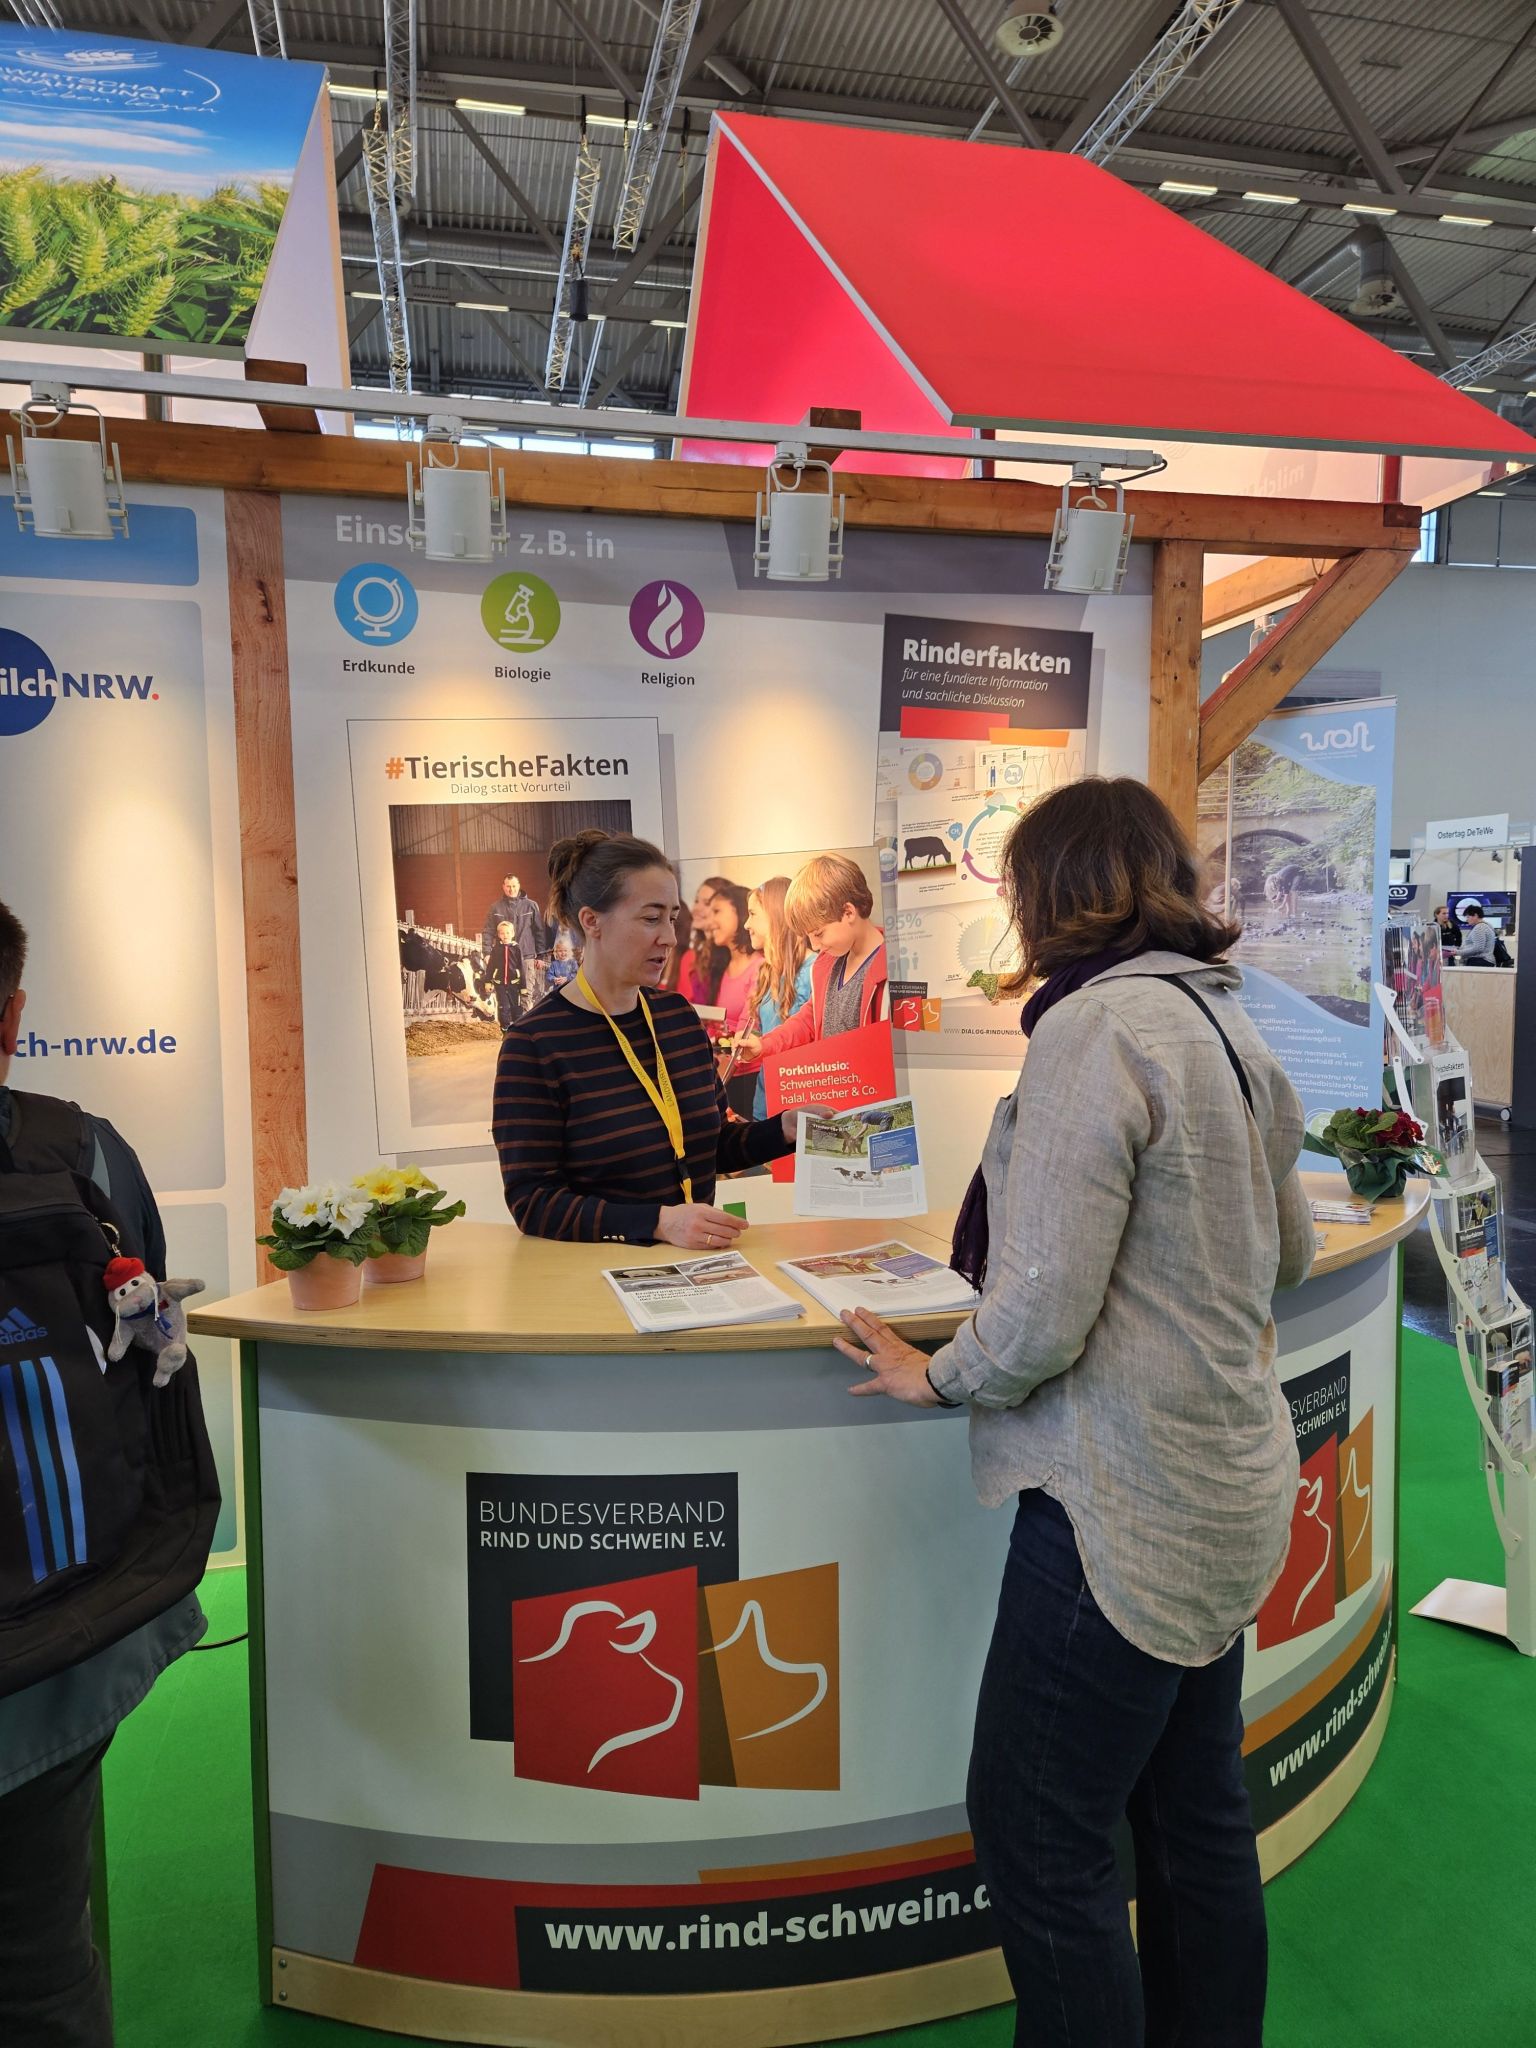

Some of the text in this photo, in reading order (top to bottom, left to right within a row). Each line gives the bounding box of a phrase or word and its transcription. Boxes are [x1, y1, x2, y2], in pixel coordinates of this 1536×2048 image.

[0, 66, 194, 96] WIRTSCHAFT
[519, 530, 576, 557] z.B.
[586, 531, 615, 559] in
[342, 659, 416, 675] Erdkunde
[903, 638, 1071, 675] Rinderfakten
[0, 667, 160, 701] ilchNRW.
[494, 666, 551, 682] Biologie
[641, 672, 695, 687] Religion
[901, 668, 1048, 692] für eine fundierte Information
[902, 689, 1025, 708] und sachliche Diskussion
[385, 753, 629, 780] #TierischeFakten
[451, 781, 571, 796] Dialog statt Vorurteil
[1438, 830, 1465, 839] Ostertag
[14, 1029, 177, 1058] ch-nrw.de
[779, 1073, 862, 1091] Schweinefleisch,
[781, 1085, 878, 1105] halal, koscher & Co.
[1289, 1375, 1347, 1420] SVERBAND
[1296, 1399, 1347, 1439] SCHWEIN E.V.
[480, 1500, 726, 1525] BUNDESVERBAND
[480, 1530, 726, 1550] RIND UND SCHWEIN E.V.
[544, 1884, 991, 1951] www.rind-schwein.d
